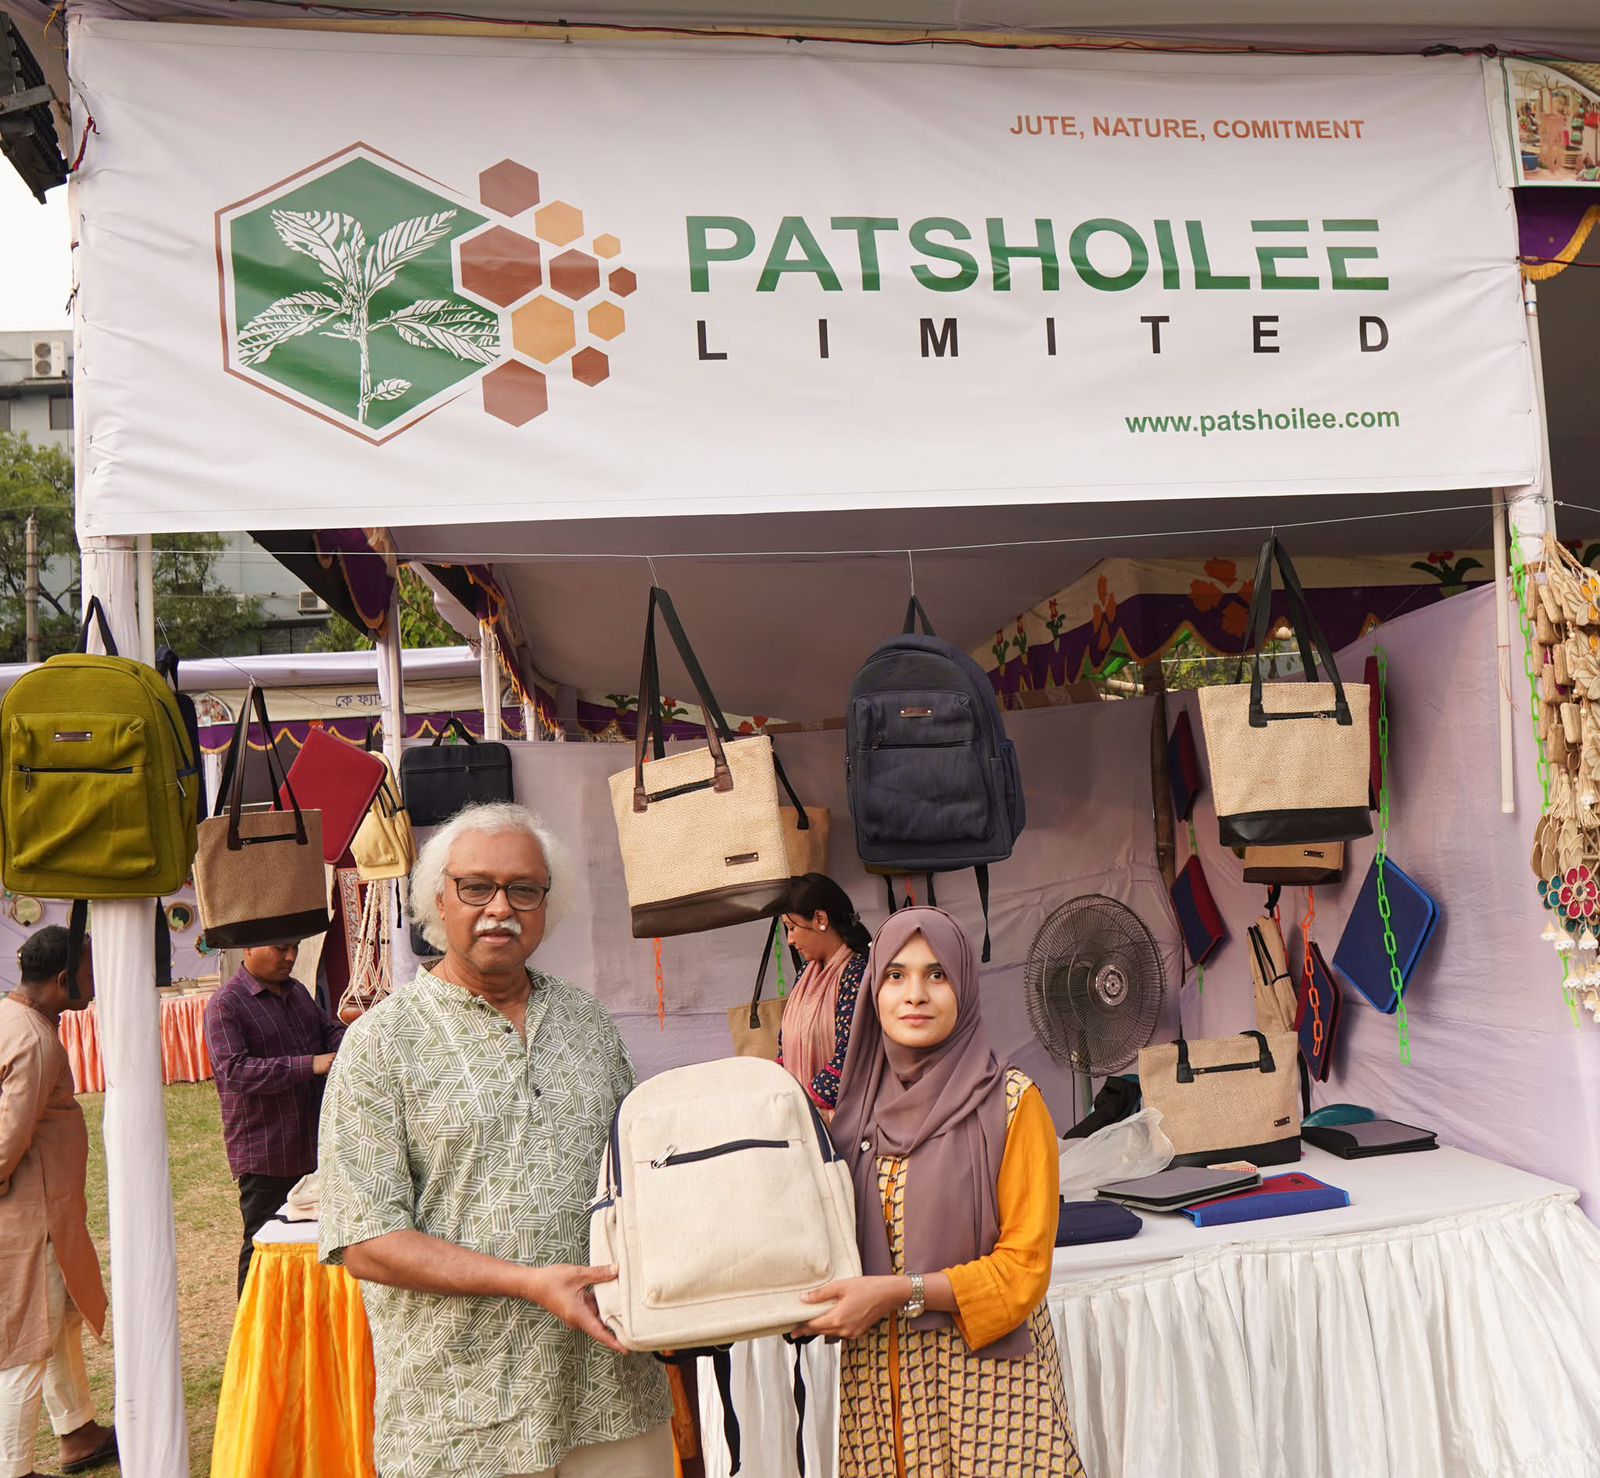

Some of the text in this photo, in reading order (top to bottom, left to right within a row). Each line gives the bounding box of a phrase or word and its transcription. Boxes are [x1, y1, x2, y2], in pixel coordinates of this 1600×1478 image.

[1010, 115, 1365, 142] JUTE, NATURE, COMITMENT
[685, 215, 1390, 293] PATSHOILEE
[696, 314, 1390, 361] LIMITED
[1125, 407, 1400, 438] www.patshoilee.com
